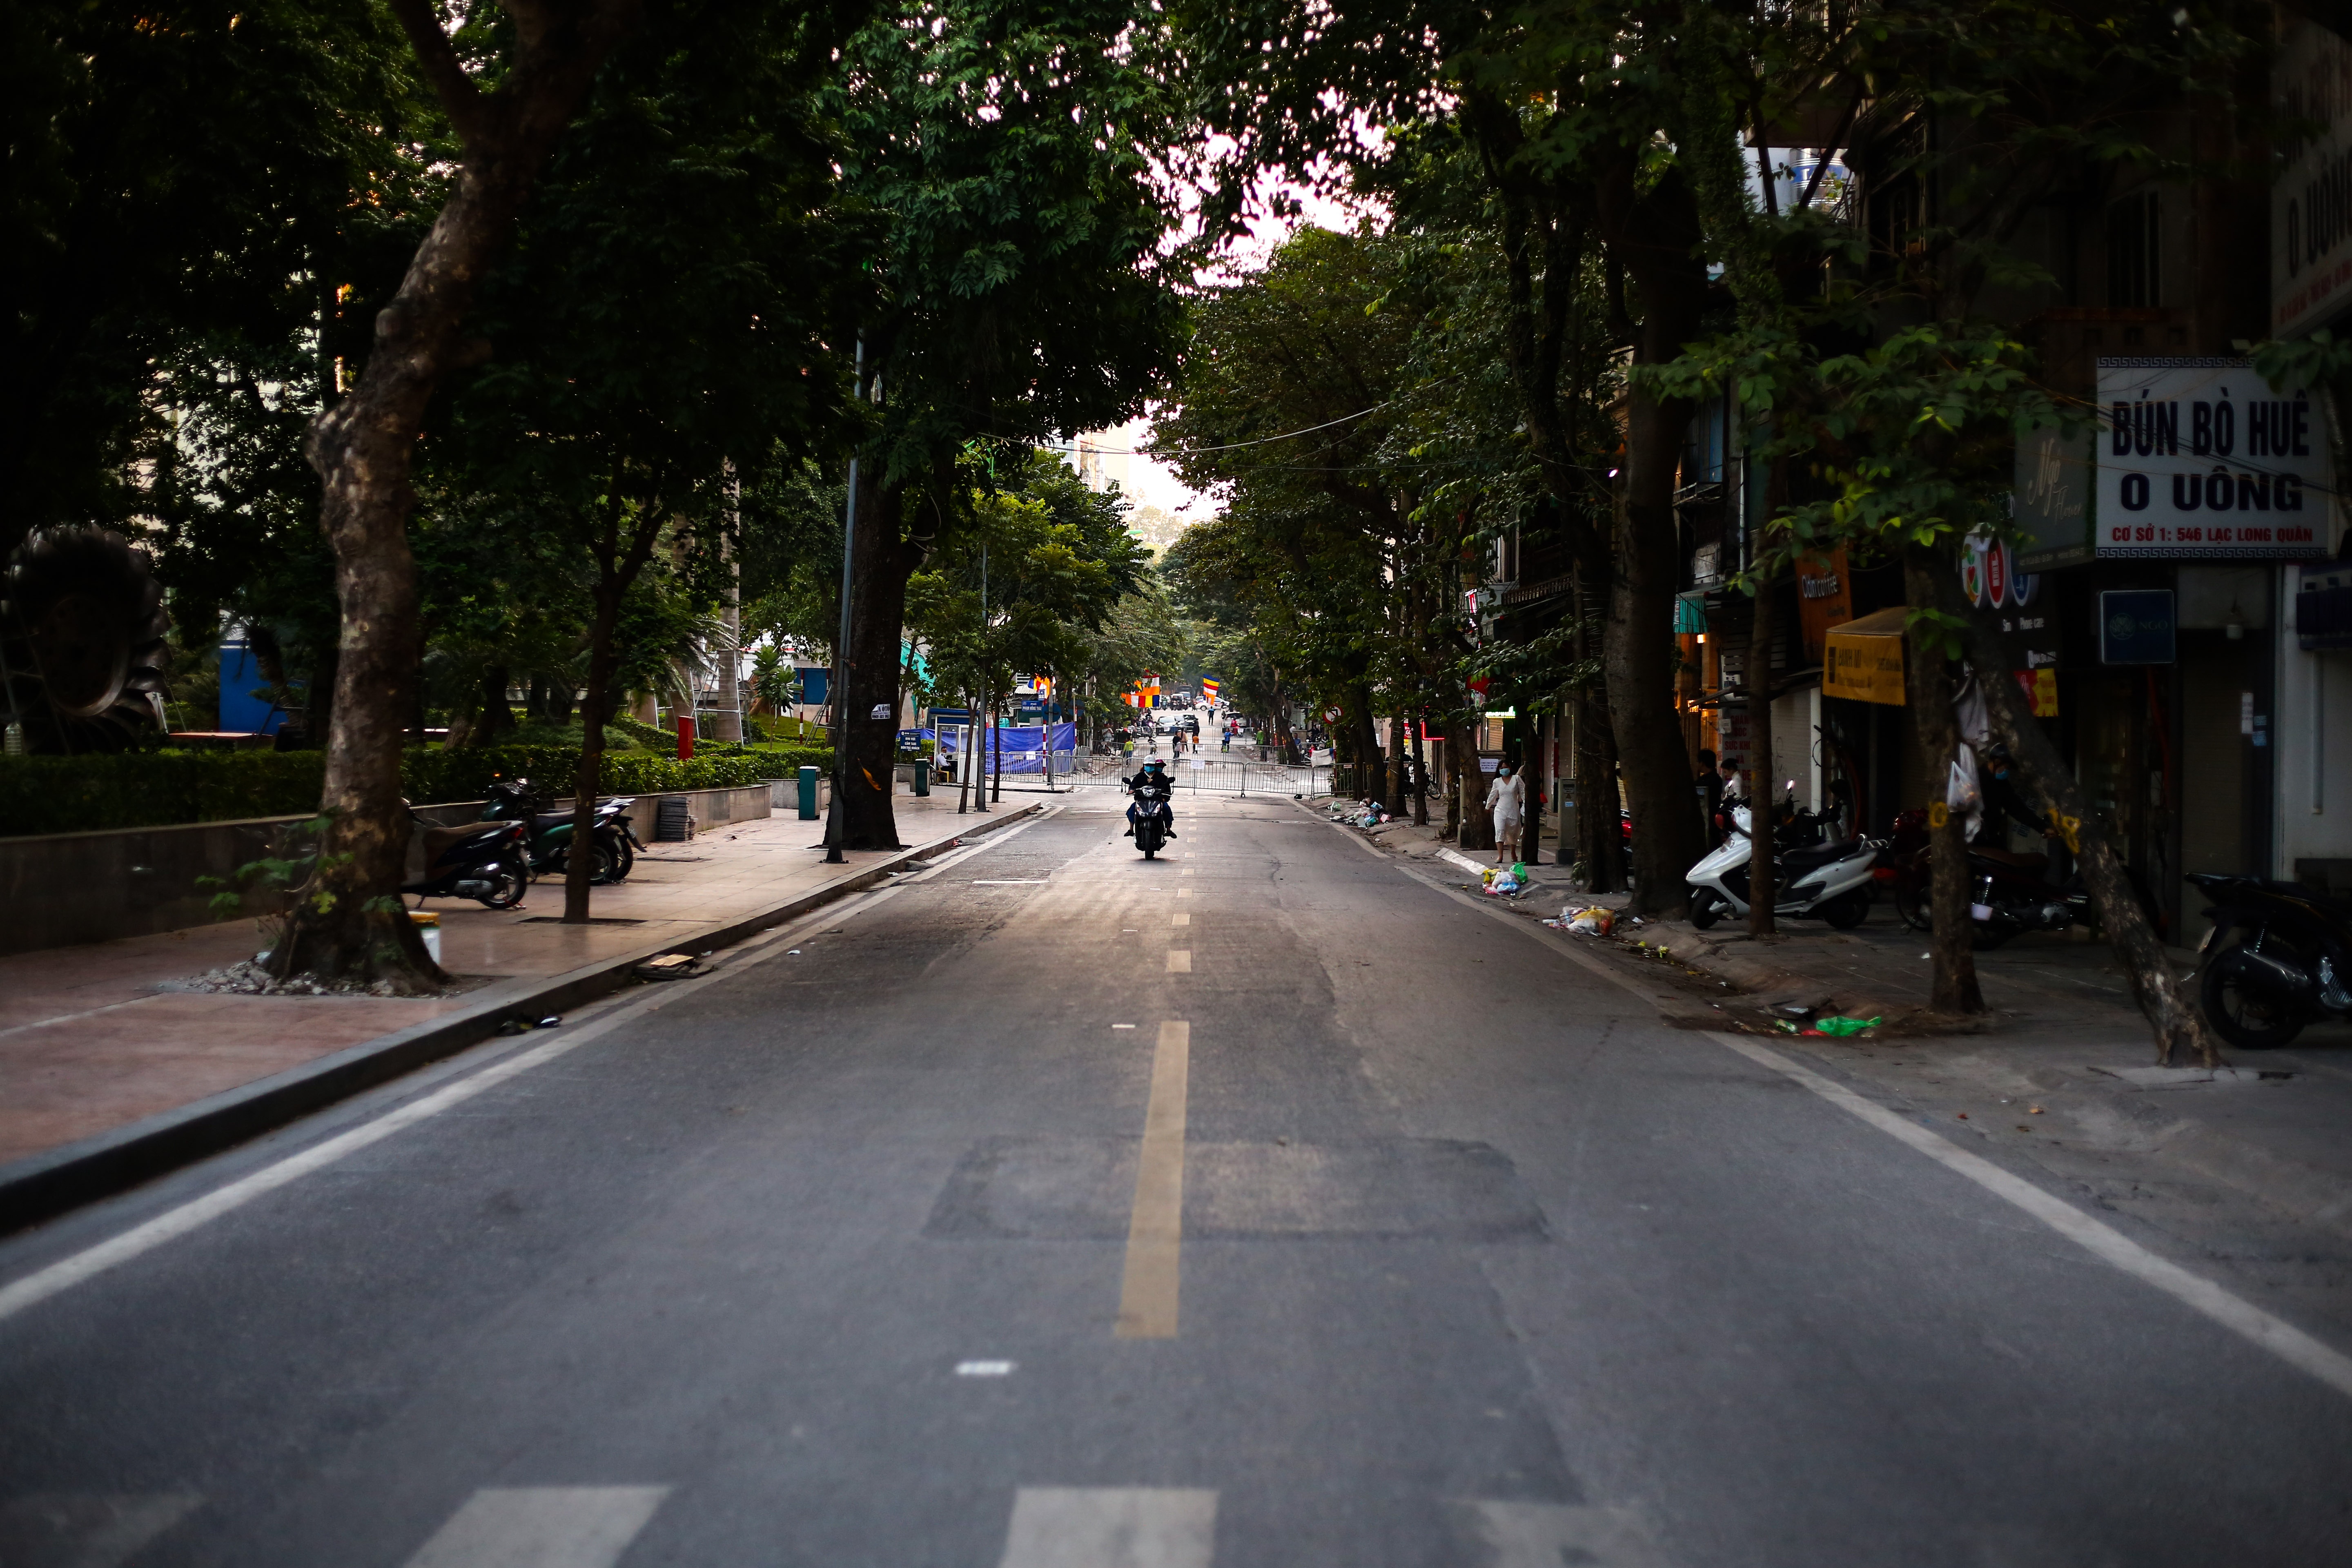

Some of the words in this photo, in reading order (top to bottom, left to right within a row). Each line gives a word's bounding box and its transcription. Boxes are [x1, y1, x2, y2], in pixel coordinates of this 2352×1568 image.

[2113, 389, 2178, 456] BÚN
[2193, 387, 2235, 457] BÒ
[2120, 473, 2150, 511] O
[2173, 465, 2303, 511] UÔNG
[2113, 526, 2131, 541] CƠ
[2136, 523, 2155, 541] SỞ
[2160, 528, 2171, 541] 1:
[2177, 528, 2202, 541] 546
[2208, 528, 2232, 544] LẠC
[2238, 528, 2272, 541] LONG
[2277, 526, 2313, 542] QUÂN
